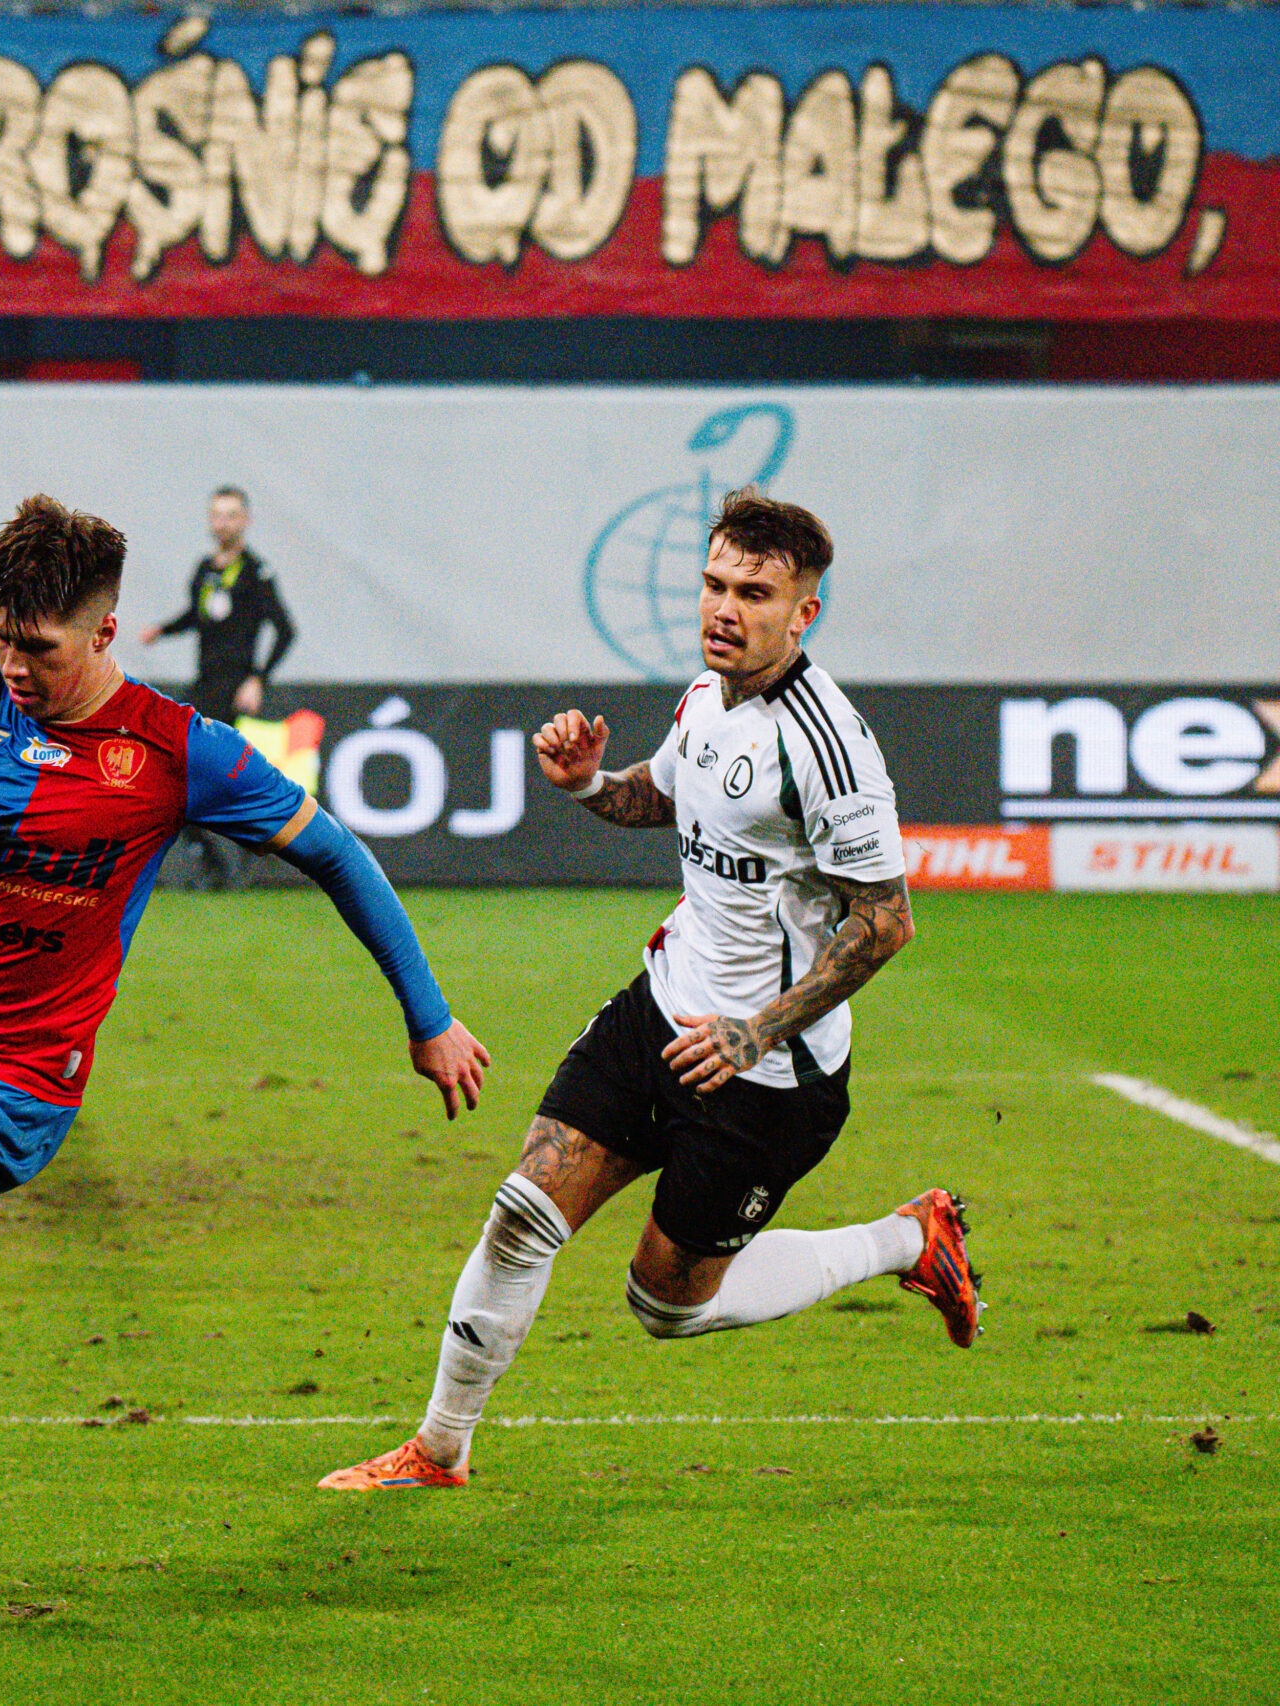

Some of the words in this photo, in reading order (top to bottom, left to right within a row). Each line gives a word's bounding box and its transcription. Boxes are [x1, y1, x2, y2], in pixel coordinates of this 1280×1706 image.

[435, 56, 639, 270] OD
[33, 748, 61, 762] LOTTO
[832, 804, 876, 827] Speedy
[832, 837, 880, 862] Królewskie
[1088, 843, 1252, 874] STIHL
